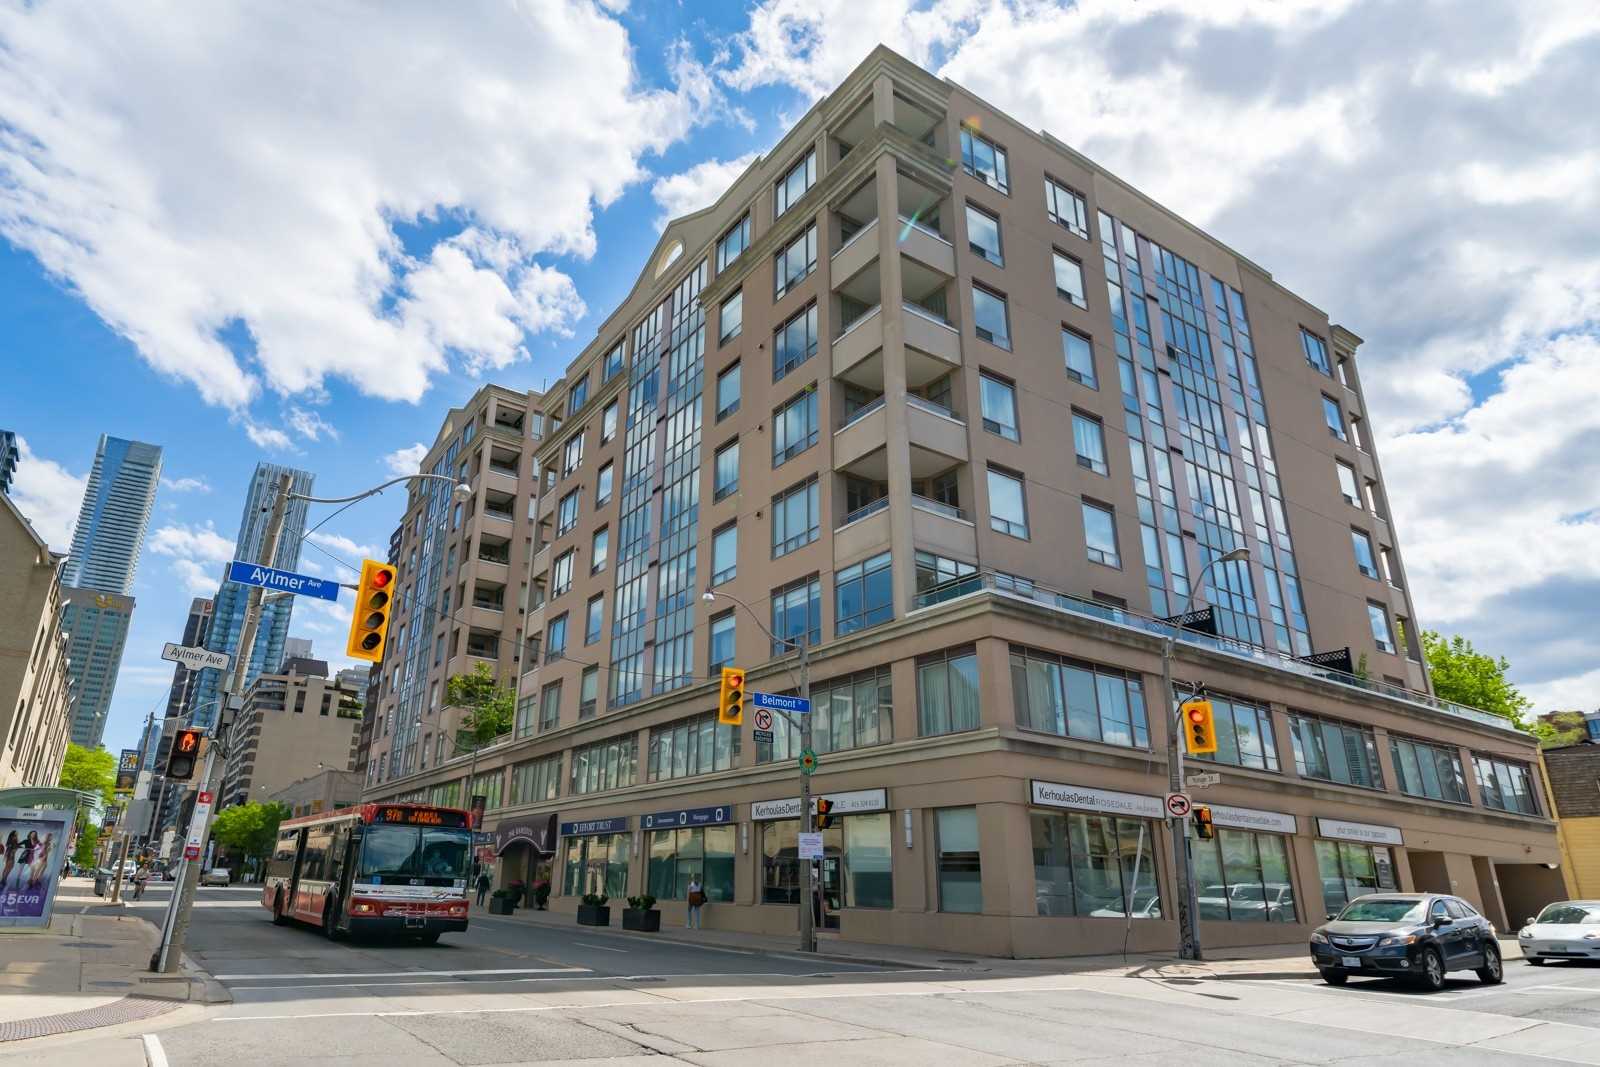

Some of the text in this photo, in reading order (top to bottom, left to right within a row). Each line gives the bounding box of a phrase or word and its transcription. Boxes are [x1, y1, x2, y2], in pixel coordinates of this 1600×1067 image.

[250, 567, 322, 589] Aylmer Ave
[170, 647, 223, 665] Aylmer Ave
[762, 694, 796, 709] Belmont
[1038, 787, 1096, 806] KerhoulasDental
[1096, 799, 1132, 810] ROSEDALE
[755, 803, 801, 817] KerhoulasDent
